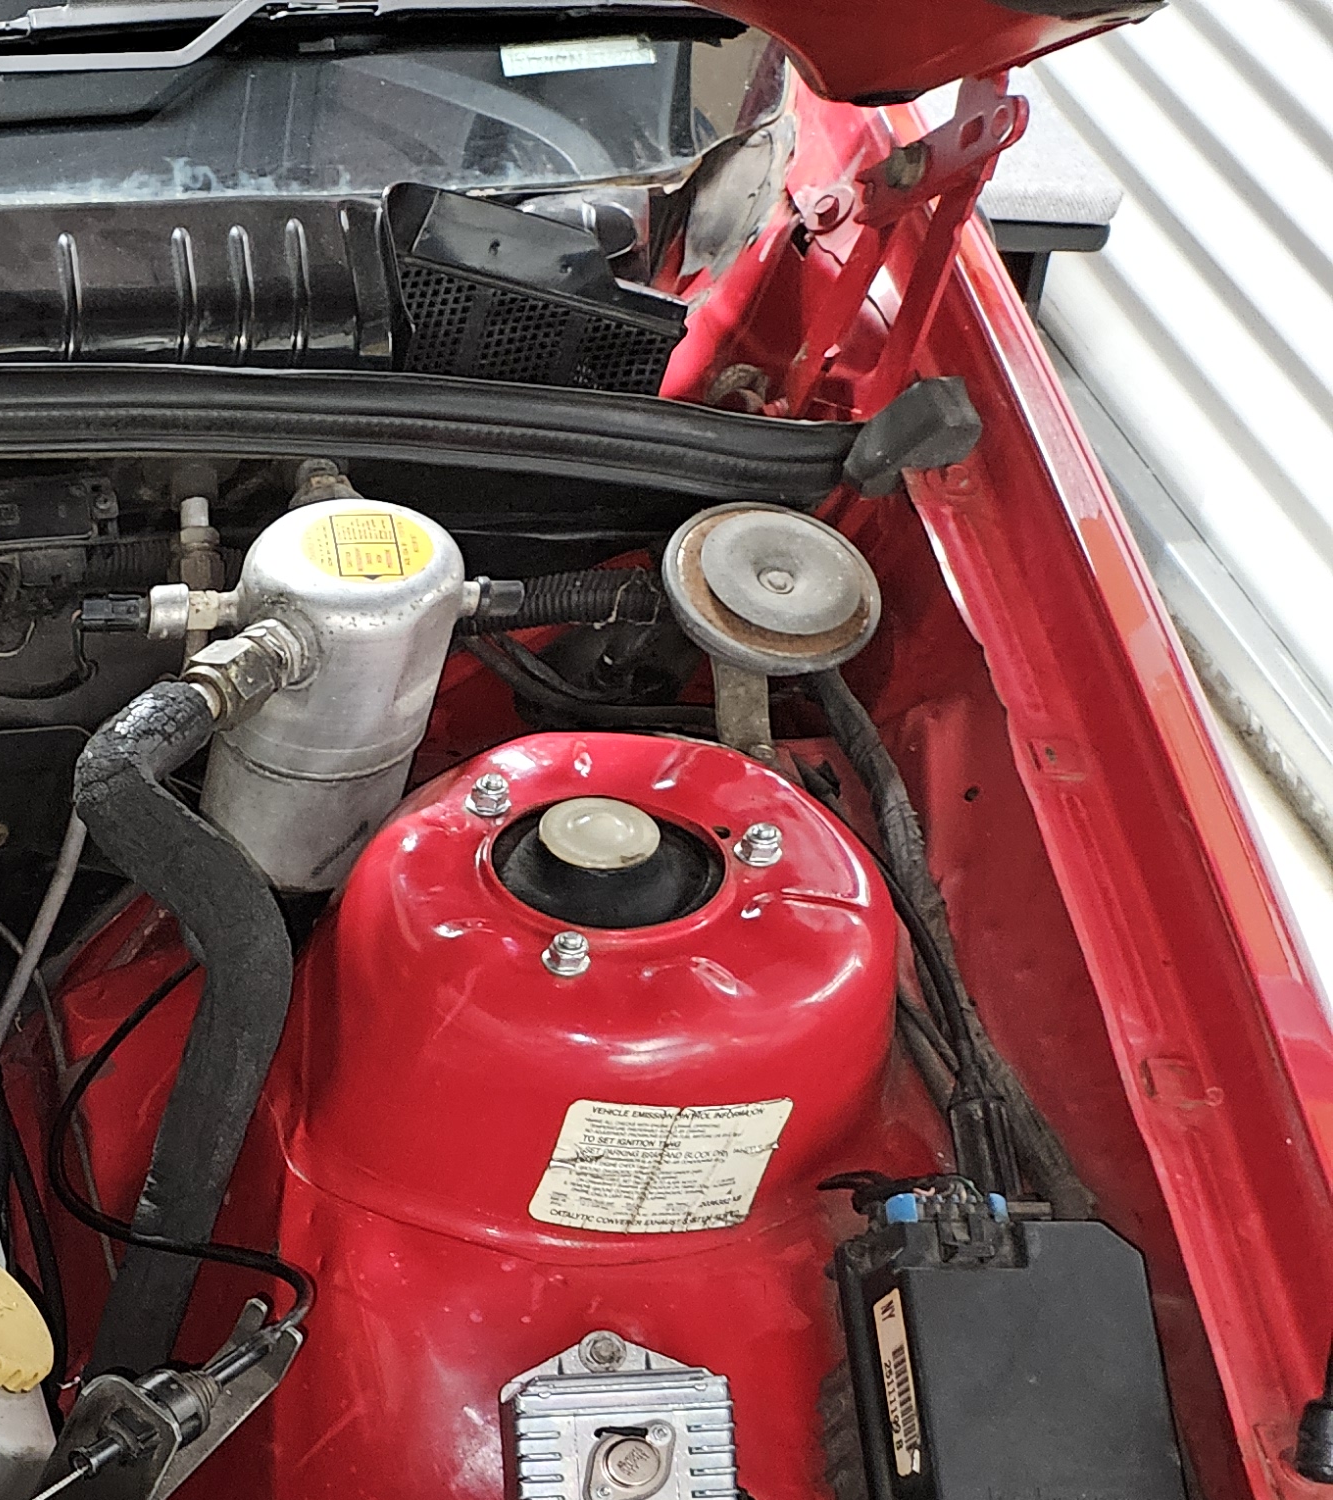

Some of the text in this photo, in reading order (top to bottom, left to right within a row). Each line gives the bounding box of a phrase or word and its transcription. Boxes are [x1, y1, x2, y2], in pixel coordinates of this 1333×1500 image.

[592, 1106, 630, 1117] VEHICLE
[583, 1134, 595, 1143] TO
[597, 1136, 615, 1144] SET
[617, 1137, 656, 1147] IGNITION
[549, 1208, 594, 1222] CATALYTIC
[881, 1299, 896, 1322] NY
